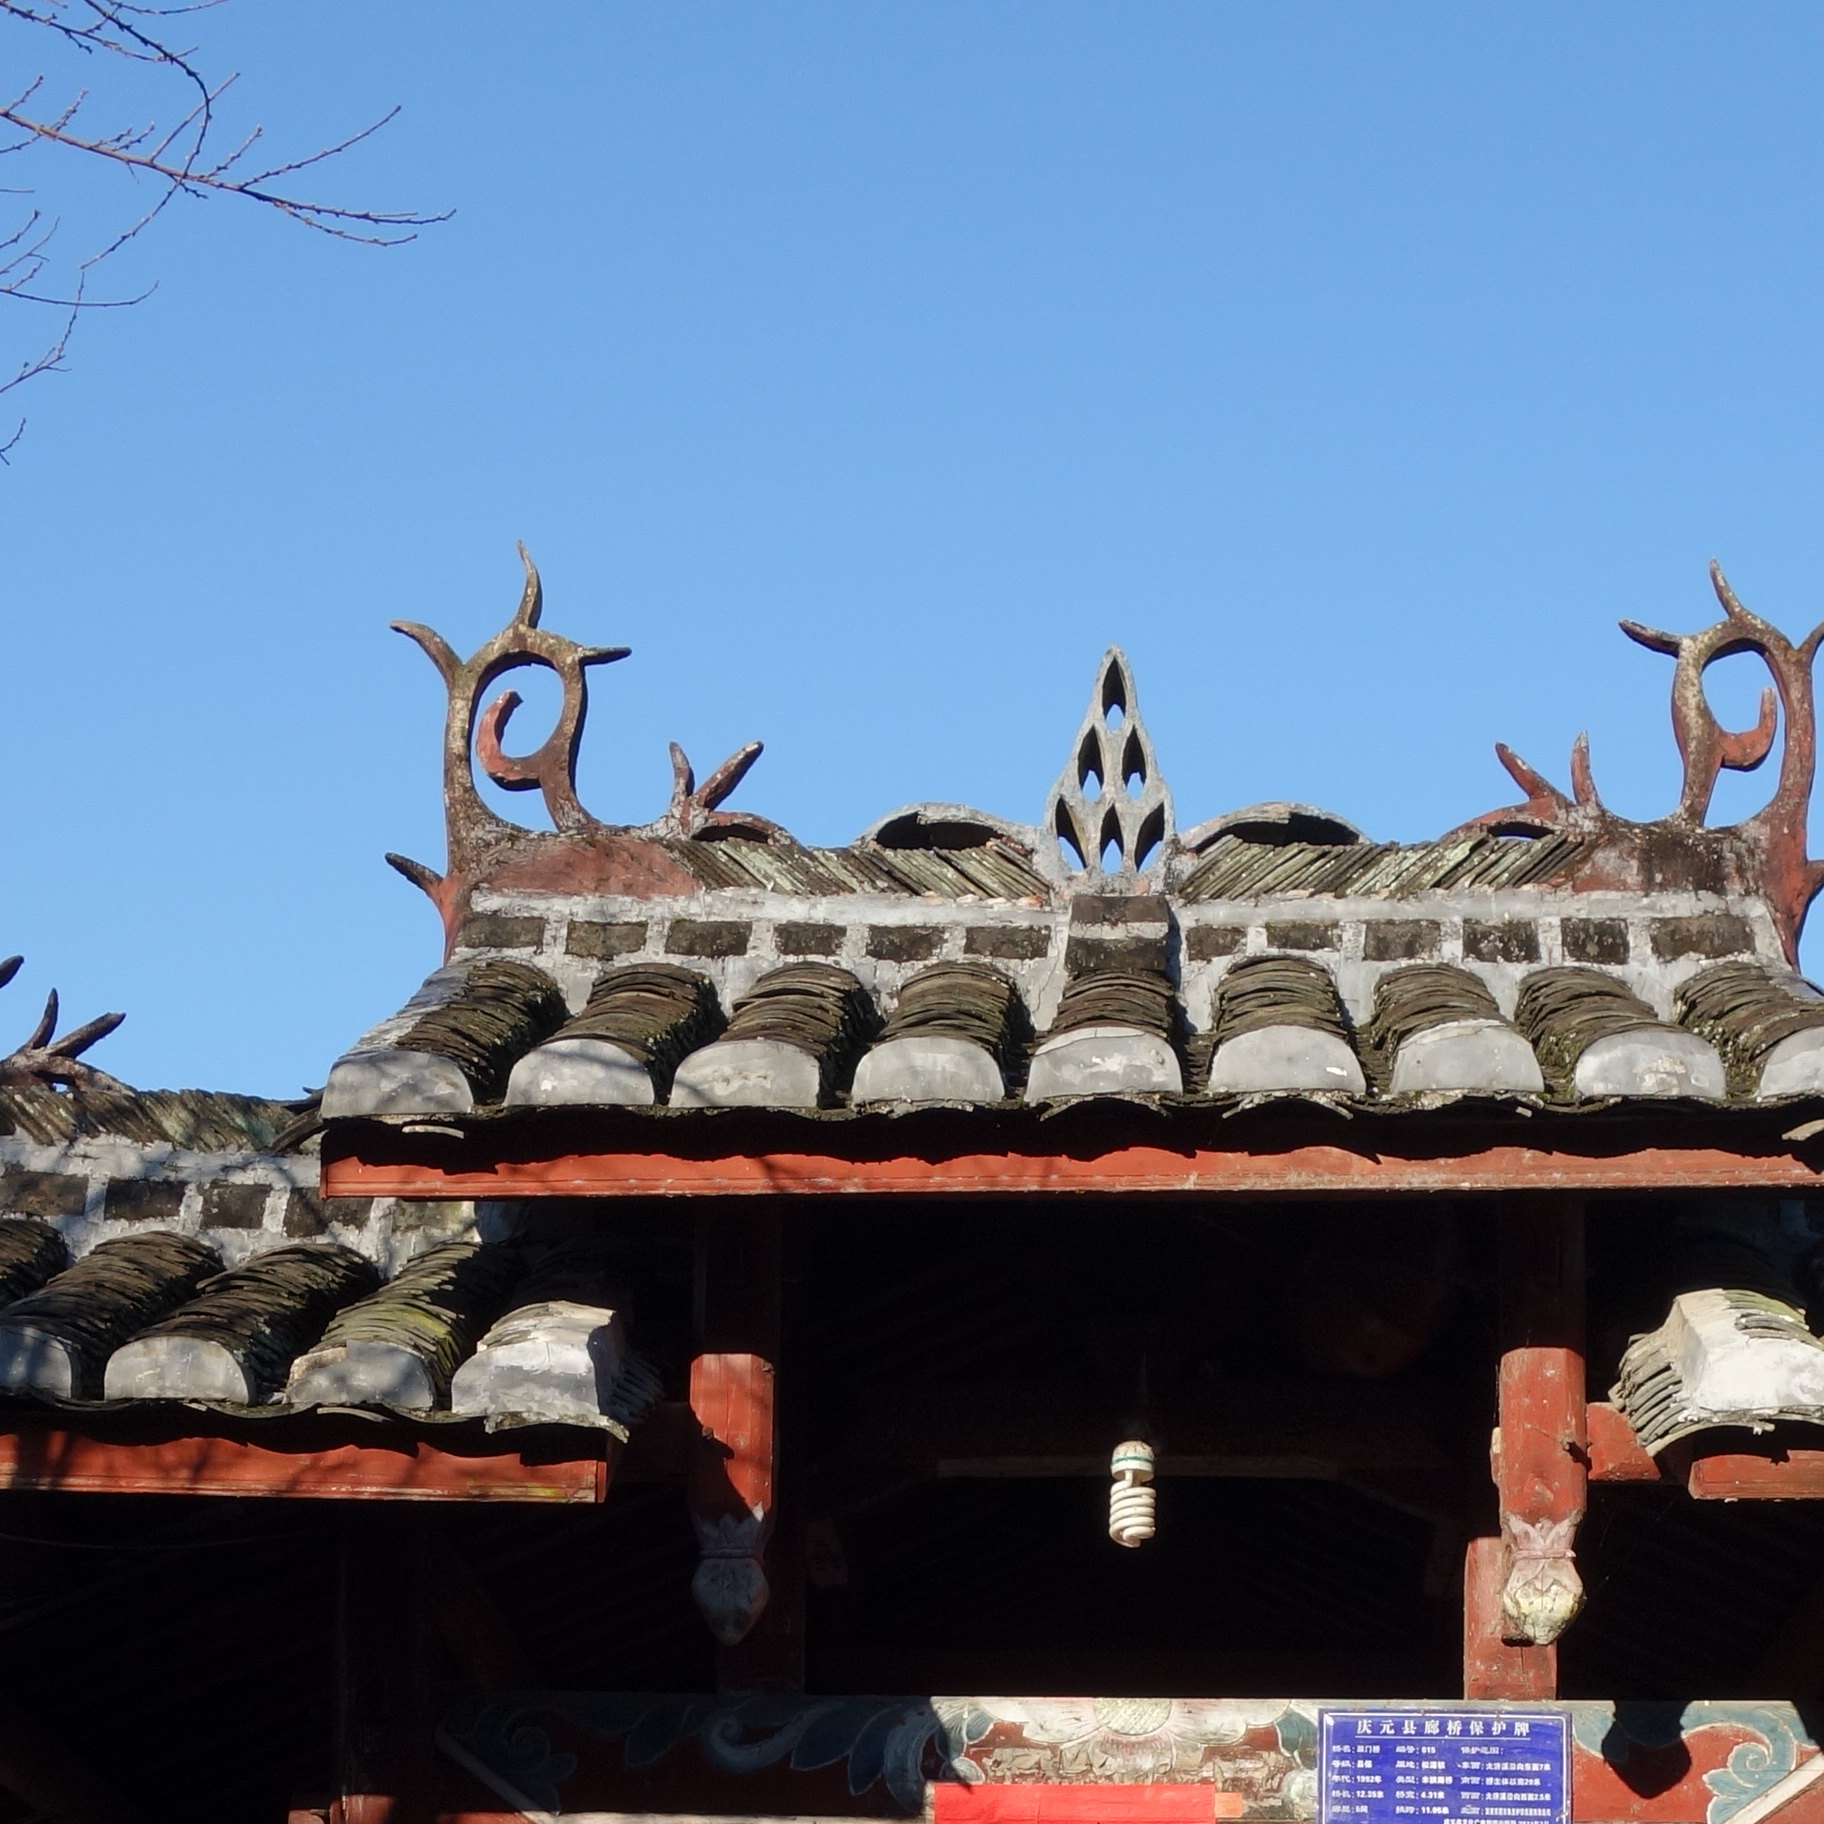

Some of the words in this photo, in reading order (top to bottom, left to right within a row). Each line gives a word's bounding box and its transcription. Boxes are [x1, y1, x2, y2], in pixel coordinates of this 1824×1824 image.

[1357, 1719, 1530, 1736] 庆元县廊桥保护牌
